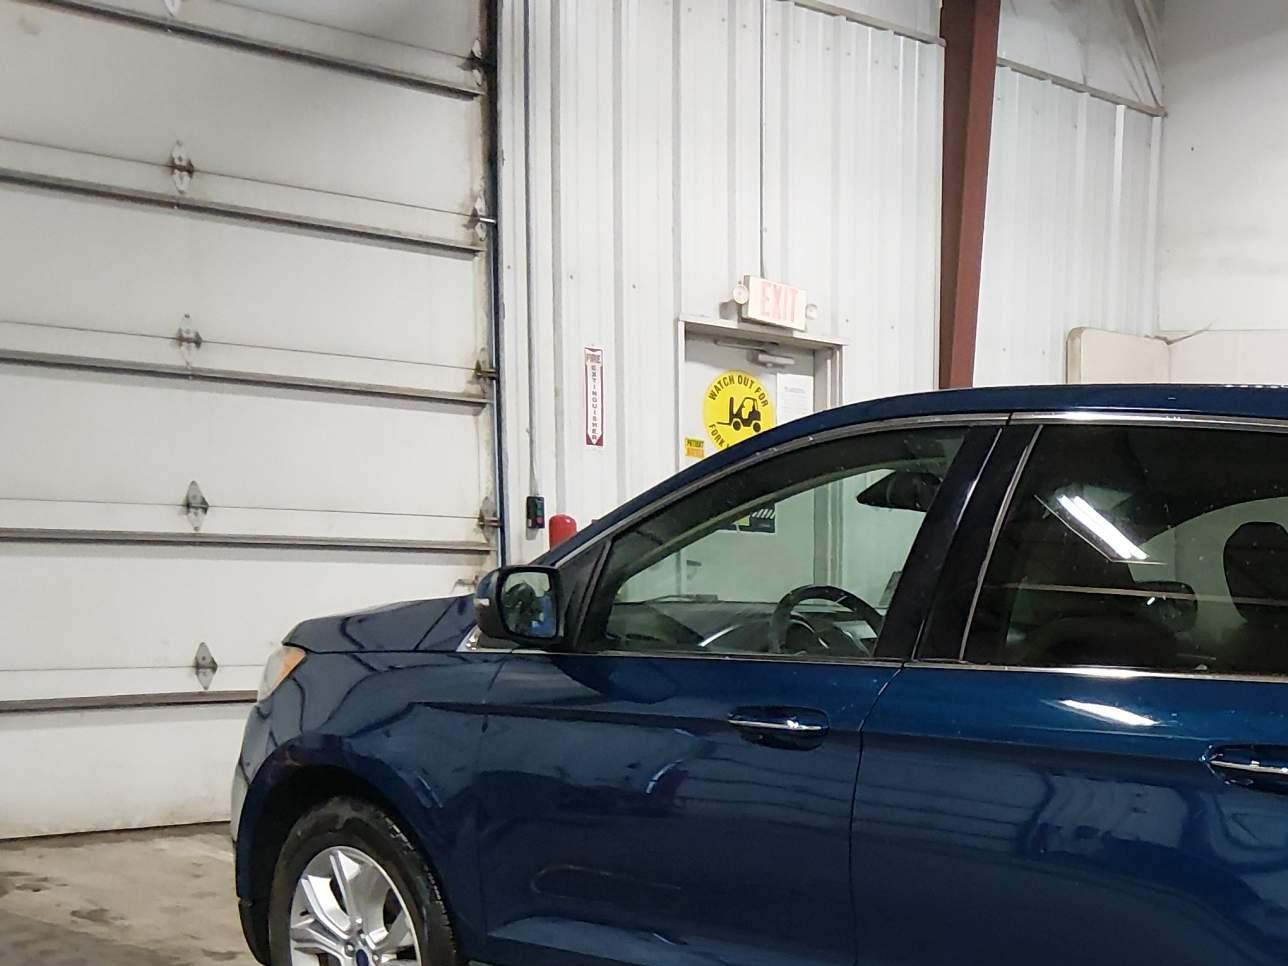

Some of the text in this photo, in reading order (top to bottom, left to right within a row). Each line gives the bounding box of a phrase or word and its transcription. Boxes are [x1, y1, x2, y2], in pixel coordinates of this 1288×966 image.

[761, 281, 799, 323] EXIT
[708, 374, 769, 407] WATCH OUT FOR
[708, 423, 725, 448] FORK
